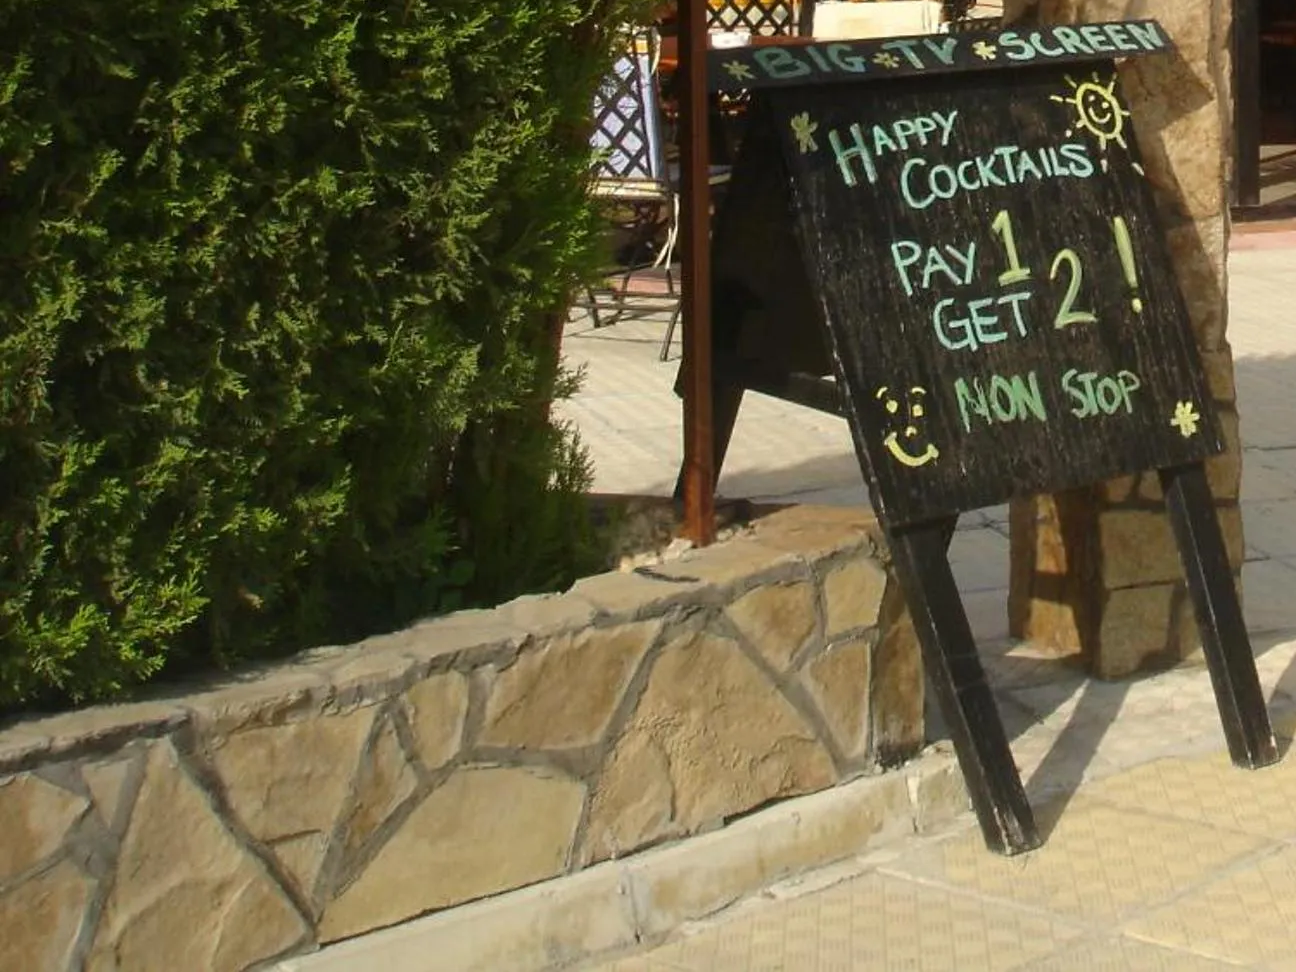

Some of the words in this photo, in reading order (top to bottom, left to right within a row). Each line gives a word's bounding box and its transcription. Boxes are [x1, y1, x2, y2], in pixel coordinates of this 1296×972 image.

[753, 43, 869, 79] BIG
[888, 36, 960, 70] TV
[1000, 21, 1166, 60] SCREEN
[828, 110, 959, 186] HAPPY
[899, 143, 1094, 209] COCKTAILS
[890, 239, 977, 295] PAY
[992, 209, 1031, 286] 1
[933, 290, 1032, 352] GET
[954, 375, 1047, 432] NON
[1061, 368, 1143, 418] STOP
